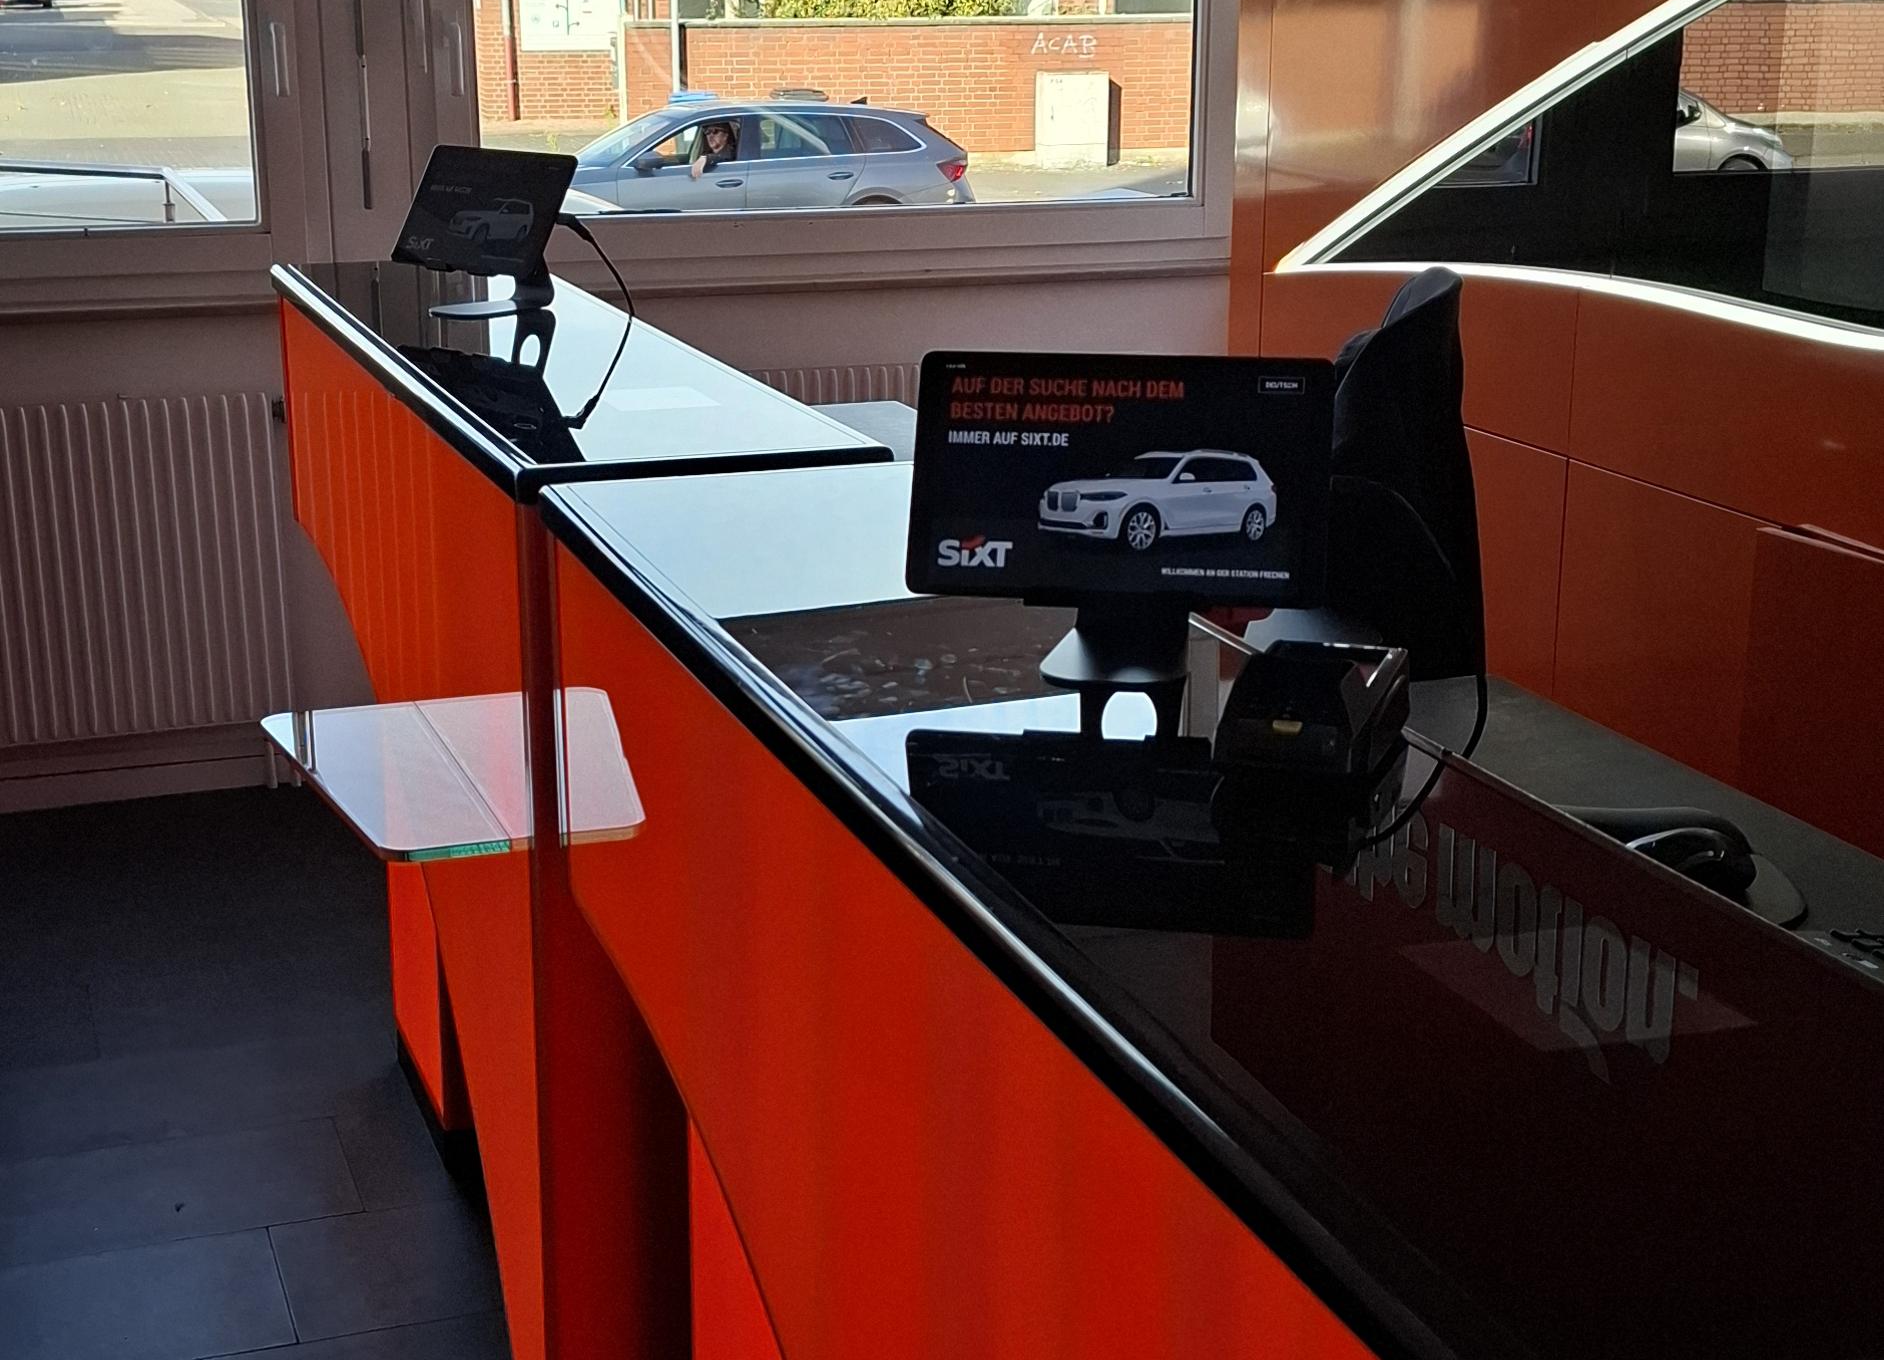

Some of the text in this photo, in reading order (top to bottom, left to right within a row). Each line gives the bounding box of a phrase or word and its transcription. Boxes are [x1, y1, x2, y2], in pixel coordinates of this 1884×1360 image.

[952, 376, 1185, 399] AUF DER SUCHE NACH DEM
[951, 402, 1115, 423] BESTEN ANGEBOT?
[948, 429, 1070, 447] IMMER AUF SIXT.DE
